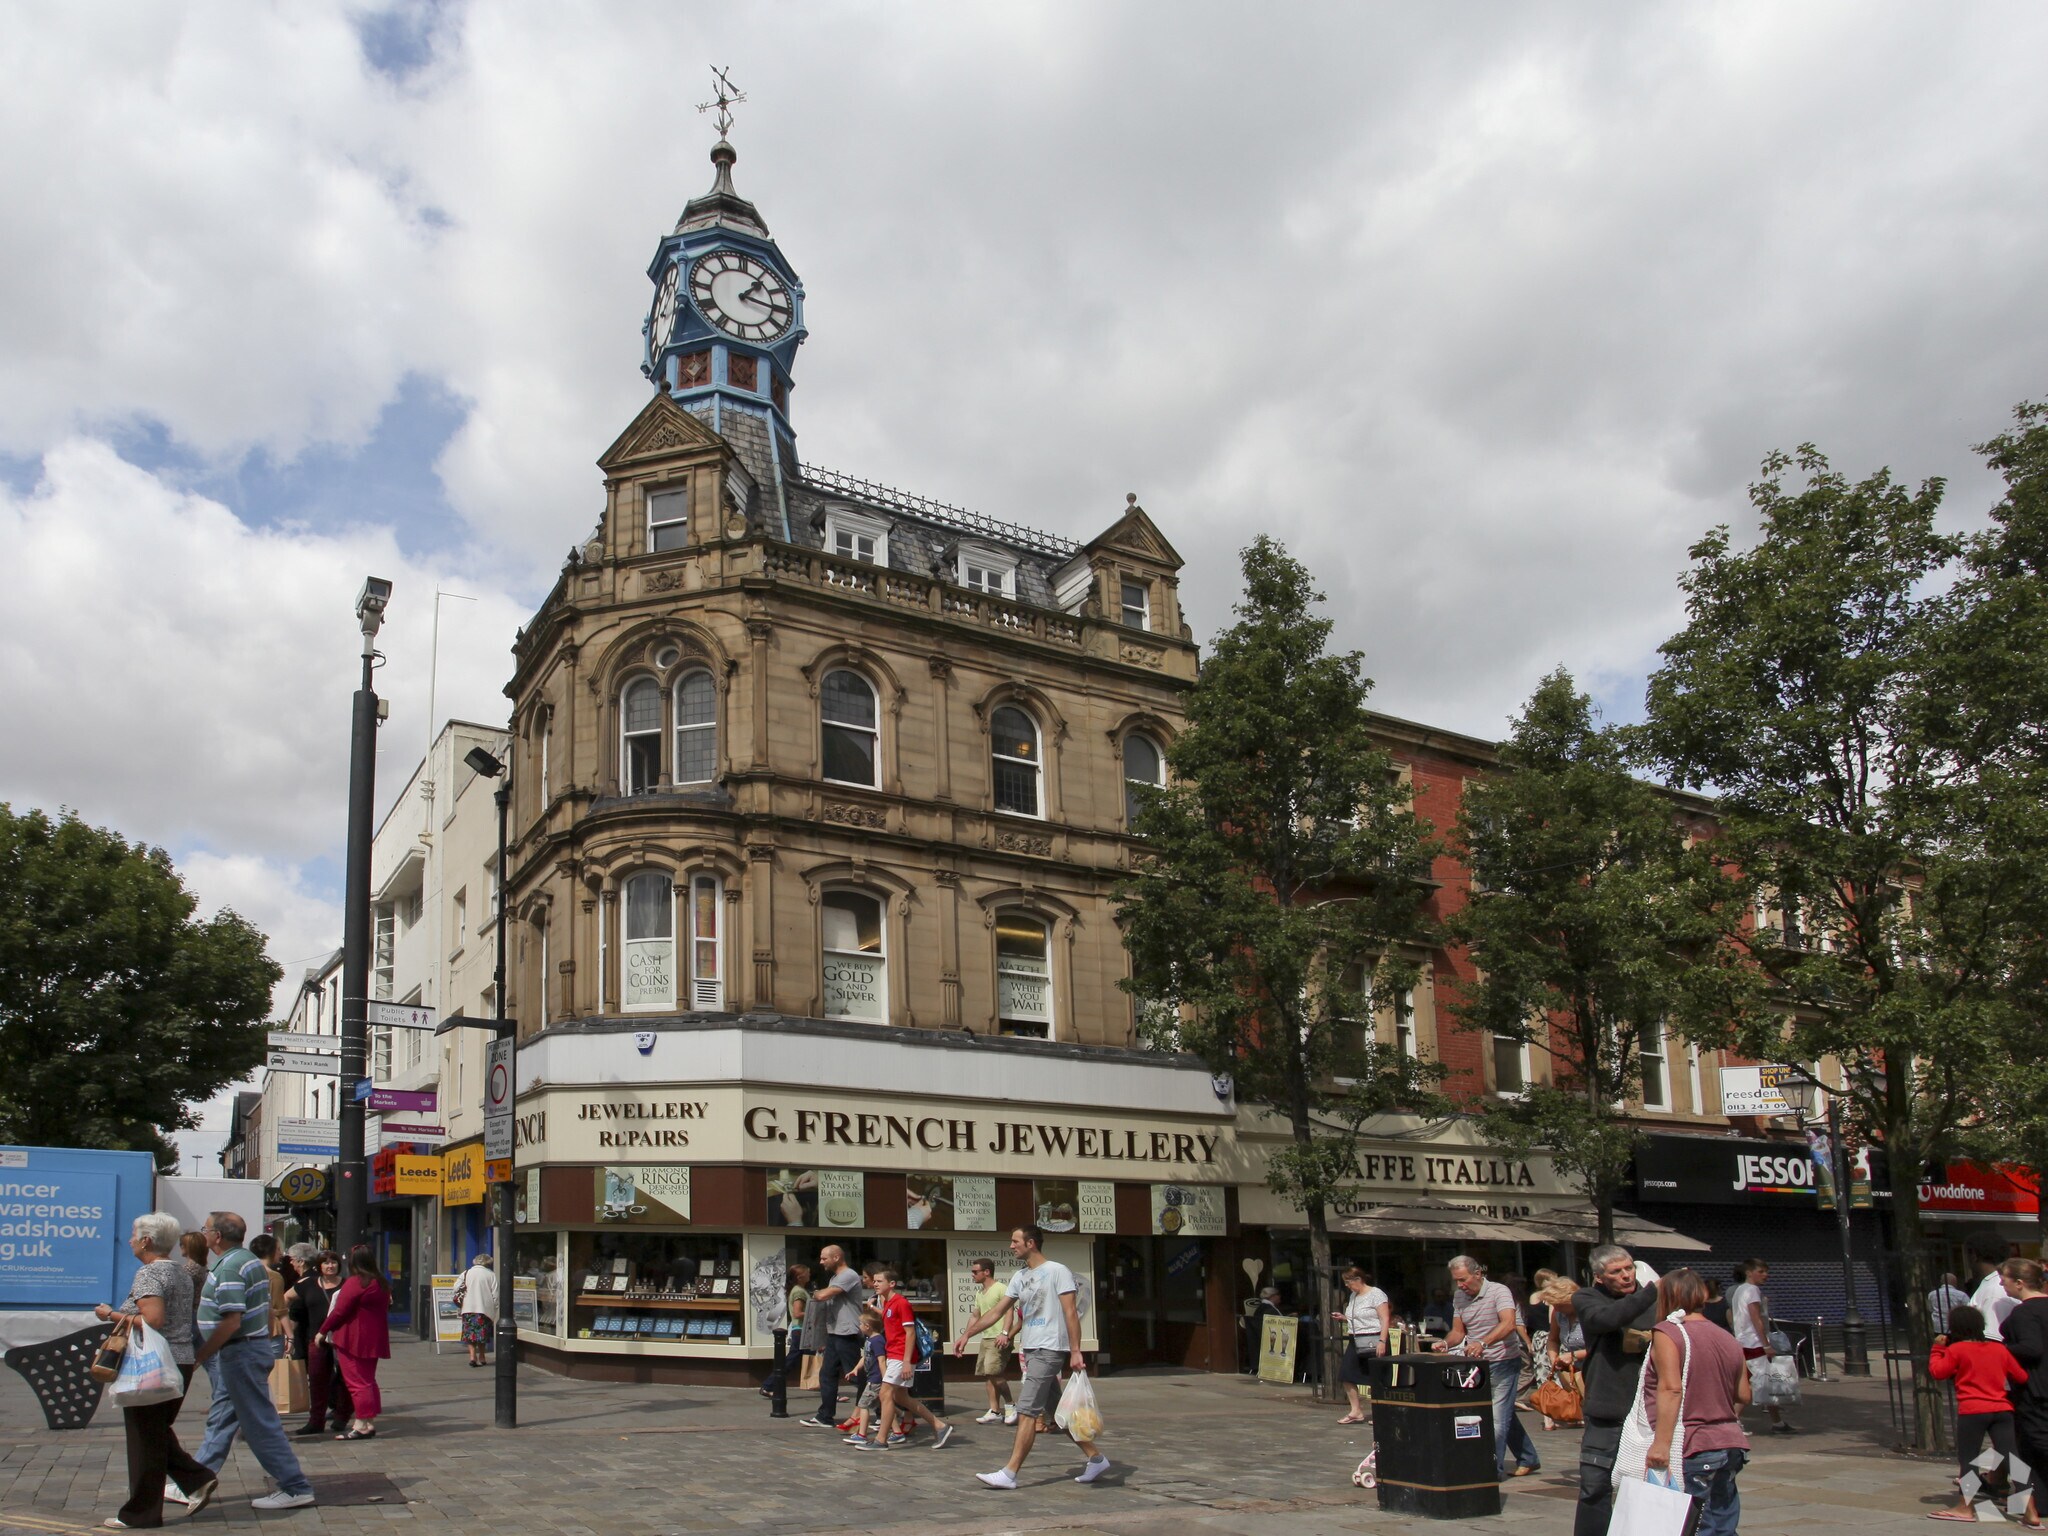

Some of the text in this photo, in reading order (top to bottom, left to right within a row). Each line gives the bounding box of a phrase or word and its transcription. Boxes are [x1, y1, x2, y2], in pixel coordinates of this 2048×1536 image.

[630, 954, 662, 967] CASH
[645, 966, 662, 974] FOR
[837, 961, 874, 971] WE BUY
[824, 965, 874, 984] GOLD
[630, 973, 669, 987] COINS
[846, 983, 868, 992] AND
[1010, 982, 1042, 993] WHILE
[836, 988, 877, 1002] SILVER
[1018, 992, 1040, 1001] YOU
[1010, 998, 1045, 1011] WAIT
[381, 1007, 405, 1015] Public
[381, 1015, 406, 1023] Toilets
[491, 1050, 507, 1063] ZONE
[578, 1102, 709, 1121] JEWELLERY
[599, 1130, 690, 1148] REPAIRS
[989, 1122, 1220, 1164] JEWELLERY
[400, 1167, 438, 1177] Leeds
[448, 1153, 472, 1182] Leeds
[1424, 1157, 1534, 1187] ITALLIA
[642, 1173, 688, 1184] RINGS
[824, 1173, 854, 1182] WATCH
[954, 1176, 994, 1184] POLISHING
[821, 1181, 850, 1190] STRAPS
[1644, 1178, 1677, 1188] jessops.com
[821, 1190, 862, 1198] BATTERIES
[956, 1192, 994, 1200] RHODIUM
[1933, 1183, 1984, 1200] vodafone
[958, 1200, 990, 1208] PLATING
[1082, 1195, 1112, 1204] GOLD
[829, 1210, 857, 1218] FITTED
[1082, 1207, 1113, 1216] SILVER
[1502, 1206, 1530, 1219] BAR
[1189, 1215, 1225, 1224] PRESTIGE
[957, 1249, 999, 1258] WORKING
[959, 1304, 966, 1312] &
